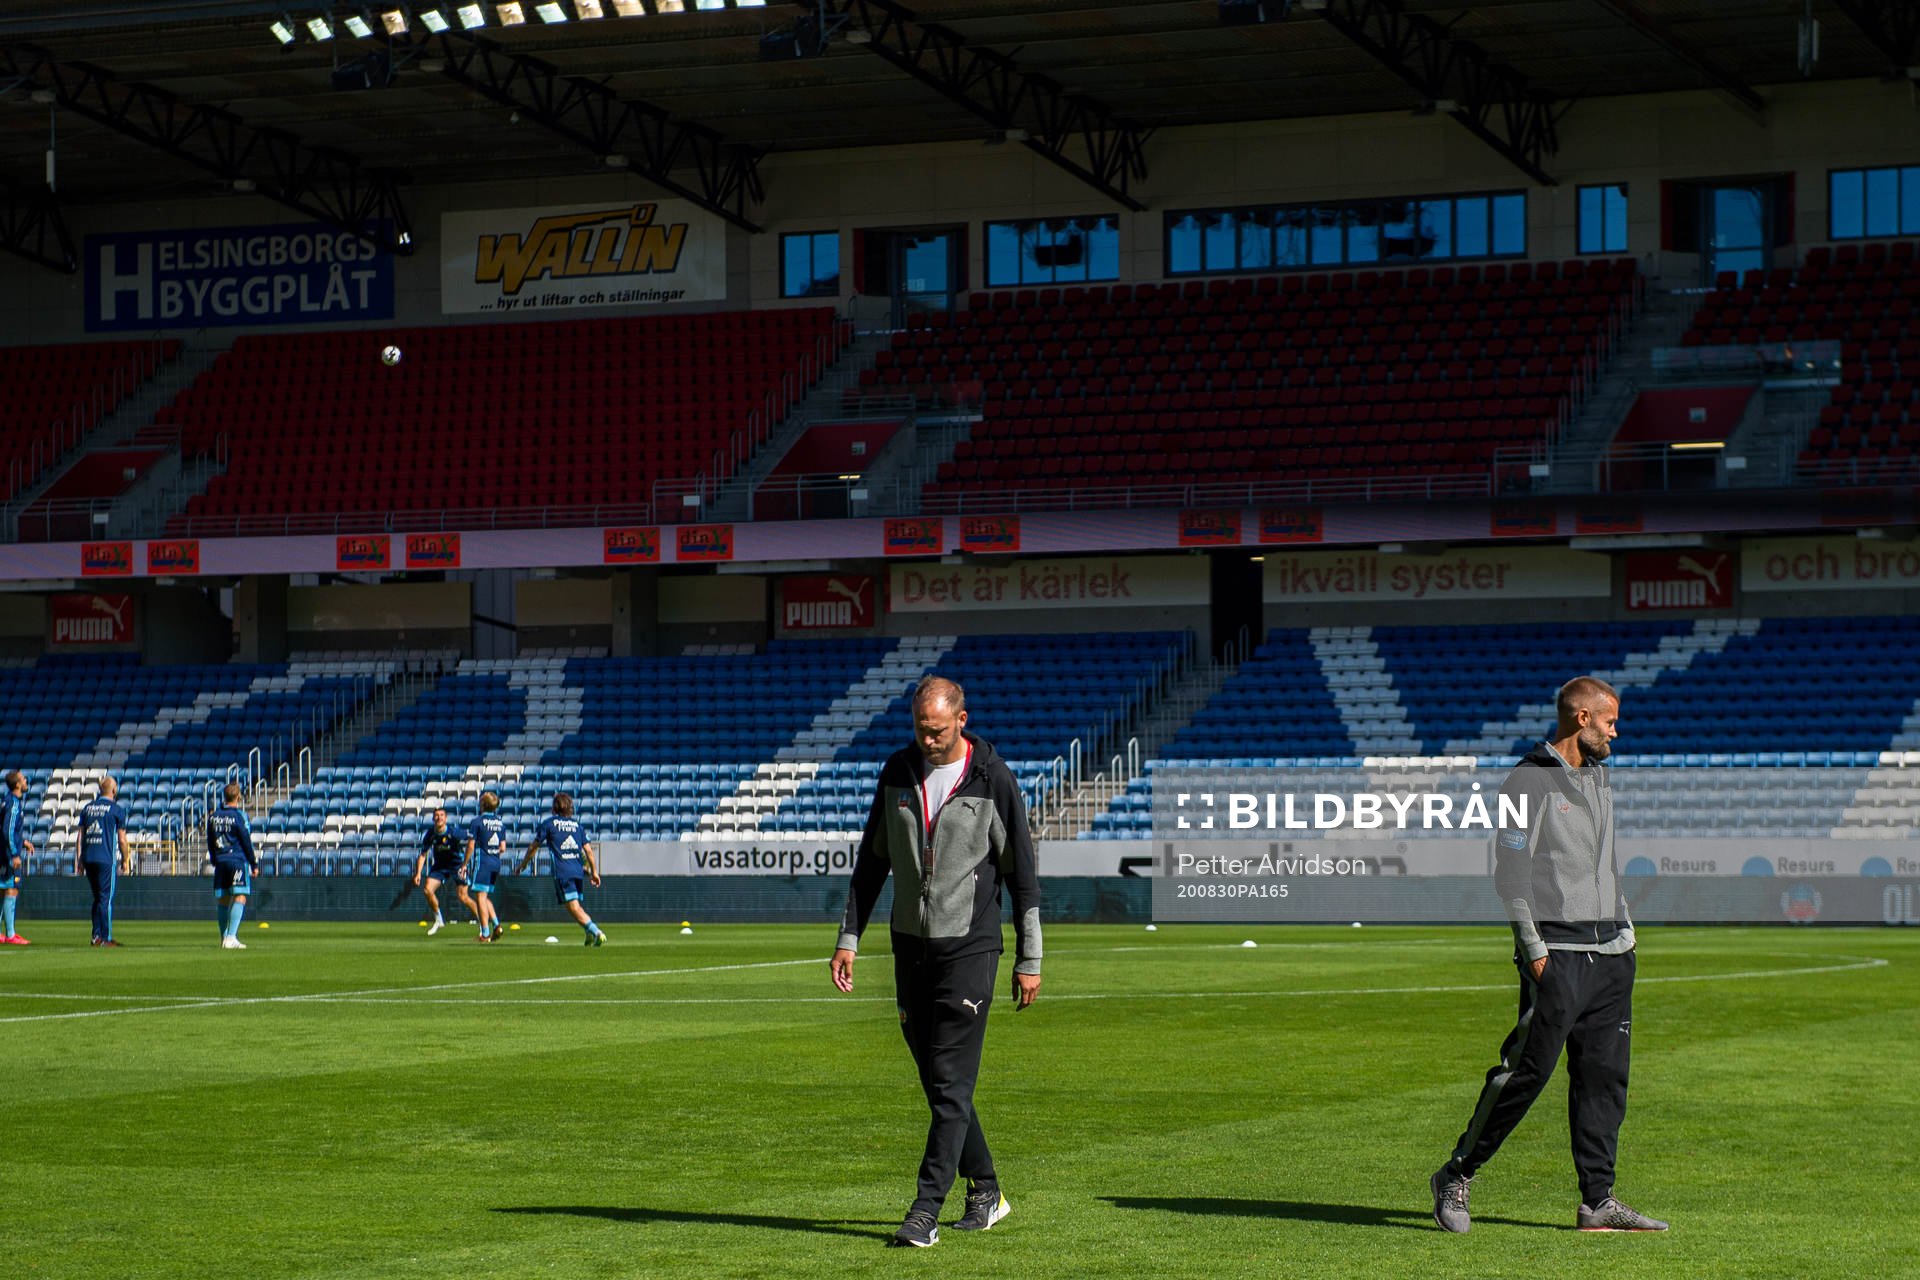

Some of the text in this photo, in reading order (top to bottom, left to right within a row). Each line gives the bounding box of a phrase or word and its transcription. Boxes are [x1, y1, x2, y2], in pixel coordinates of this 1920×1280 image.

[475, 204, 689, 295] WALLIN
[497, 296, 520, 312] hyr
[523, 295, 537, 307] ut
[541, 293, 576, 307] liftar
[579, 291, 605, 305] och
[608, 288, 686, 305] ställningar
[1764, 544, 1840, 581] och
[903, 559, 1132, 603] Det är kärlek
[1280, 556, 1511, 598] ikväll syster
[1629, 579, 1707, 607] PUMA
[786, 600, 853, 627] PUMA
[56, 616, 114, 641] PUMA
[1660, 856, 1717, 873] Resurs
[1777, 857, 1835, 873] Resurs
